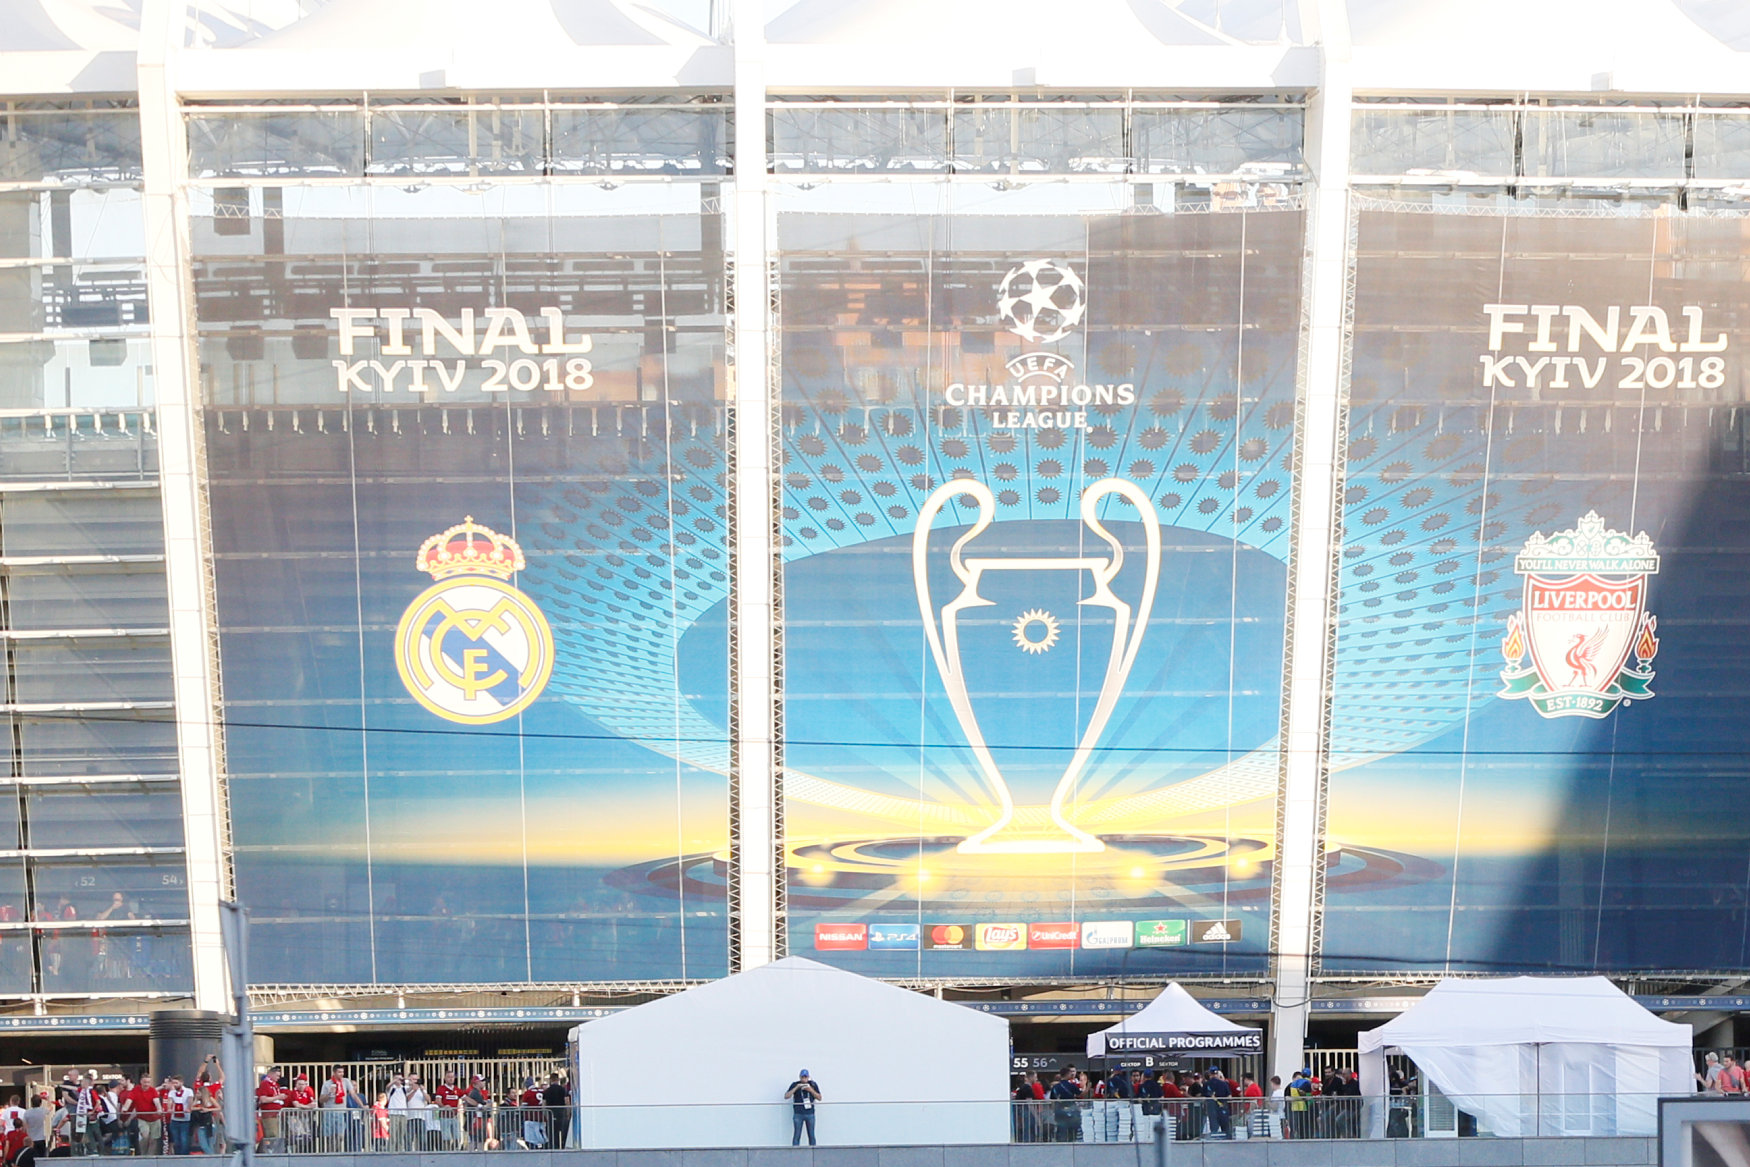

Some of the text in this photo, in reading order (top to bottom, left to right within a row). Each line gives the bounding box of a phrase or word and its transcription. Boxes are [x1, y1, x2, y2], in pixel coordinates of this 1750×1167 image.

[330, 307, 592, 355] FINAL
[1483, 304, 1728, 352] FINAL
[332, 358, 594, 392] KYIV 2018
[1008, 356, 1068, 379] UEFA
[1479, 355, 1725, 388] KYIV 2018
[945, 383, 1135, 406] CHAMPIONS
[992, 412, 1088, 429] LEAGUE
[1520, 559, 1655, 570] YOU'LL NEVER WALK ALONE
[1533, 591, 1636, 609] LIVERPOOL
[1536, 612, 1630, 623] FOOTBALL CLUB
[819, 933, 863, 941] NISSAN
[886, 931, 917, 941] PS4
[1041, 931, 1079, 941] UniCredit
[1139, 933, 1181, 945] Heineken
[1202, 932, 1230, 940] adidas
[1109, 1035, 1261, 1050] OFFICIAL PROGRAMMES
[1013, 1058, 1048, 1068] 55 56
